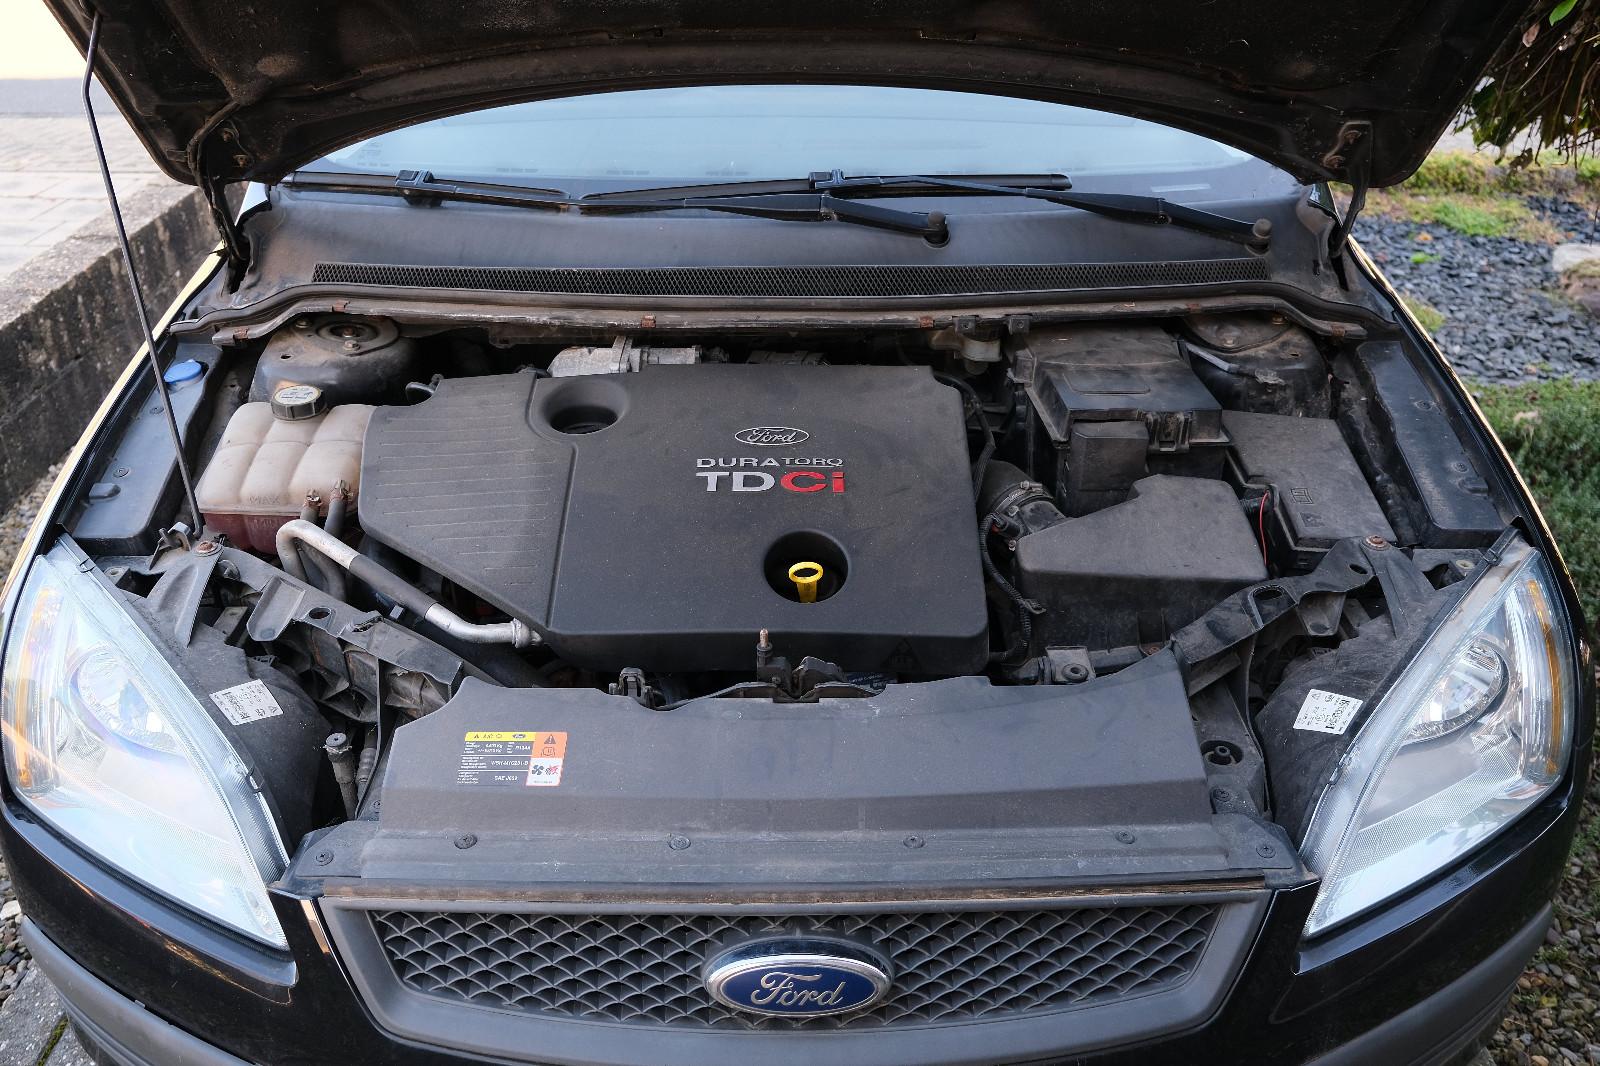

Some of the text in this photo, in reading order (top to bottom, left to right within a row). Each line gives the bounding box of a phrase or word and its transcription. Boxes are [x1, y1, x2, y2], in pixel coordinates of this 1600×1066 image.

[747, 428, 797, 442] Ford
[696, 457, 844, 468] DURATORQ
[695, 471, 845, 493] TDCi
[751, 971, 846, 1006] Ford
